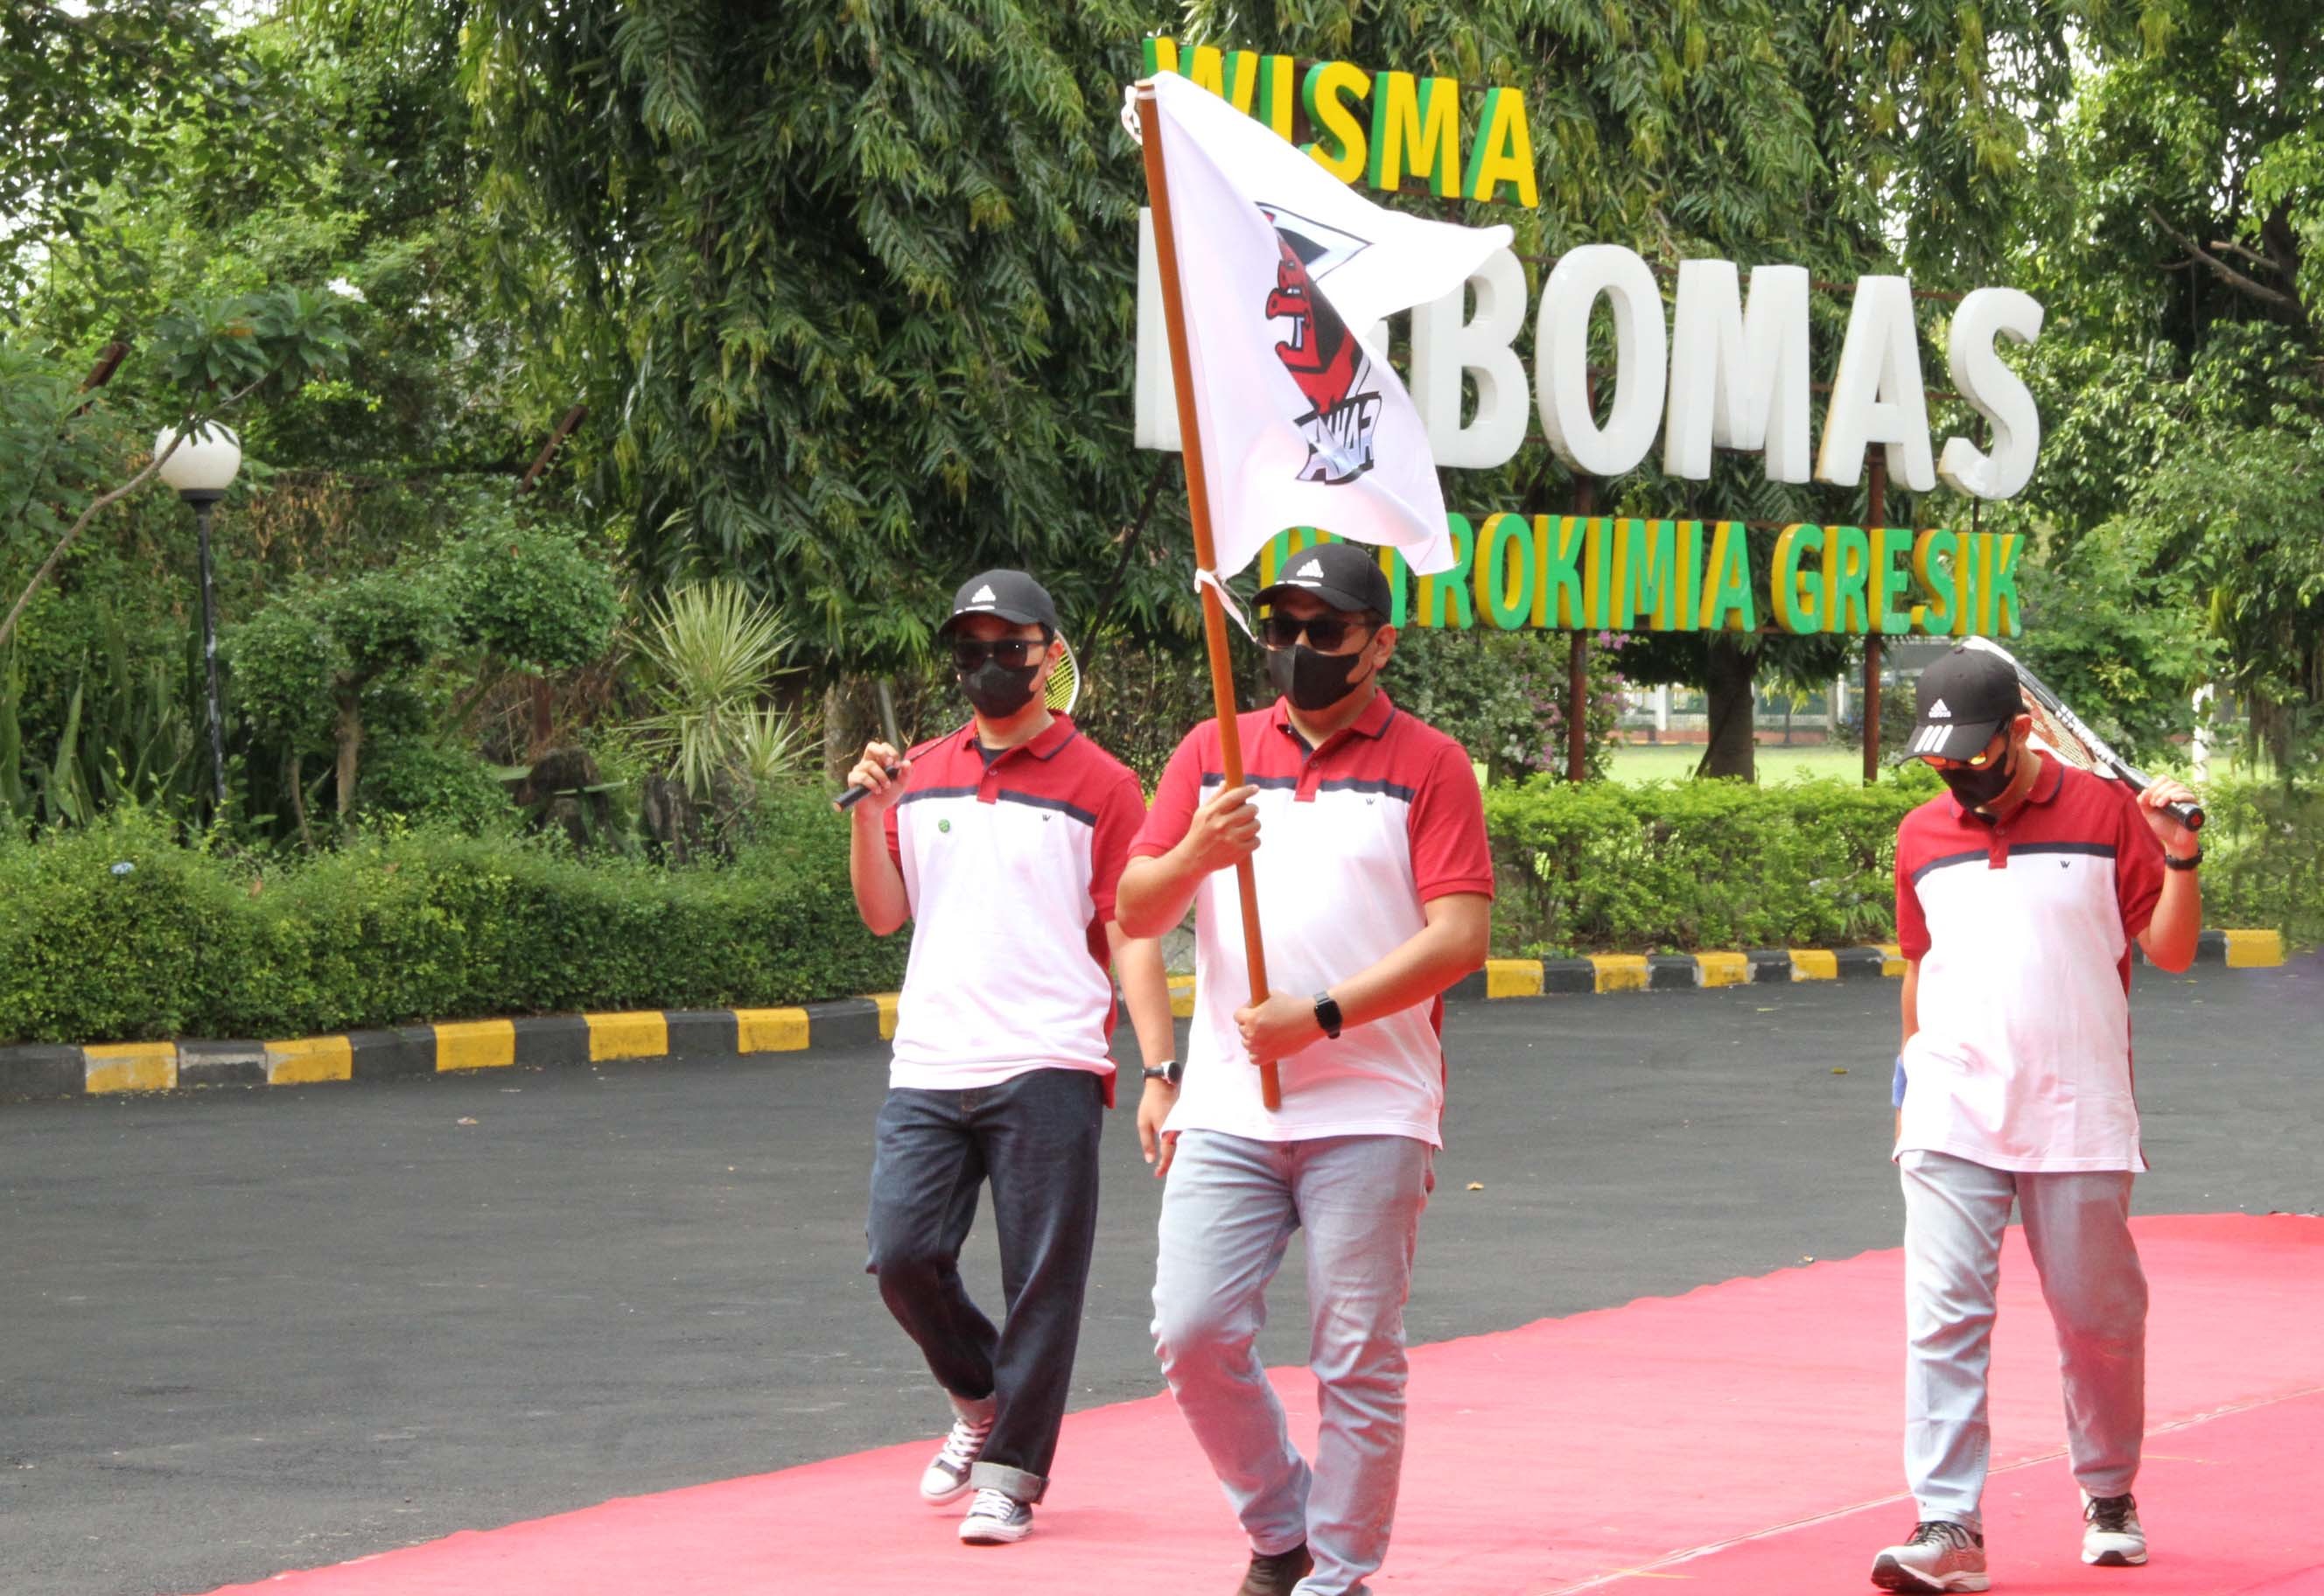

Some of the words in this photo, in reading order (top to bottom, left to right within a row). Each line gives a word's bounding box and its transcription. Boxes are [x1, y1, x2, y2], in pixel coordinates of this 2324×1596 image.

[1135, 207, 2044, 500] BOMAS
[1260, 511, 1755, 634] ROKIMIA
[1771, 523, 2026, 639] GRESIK
